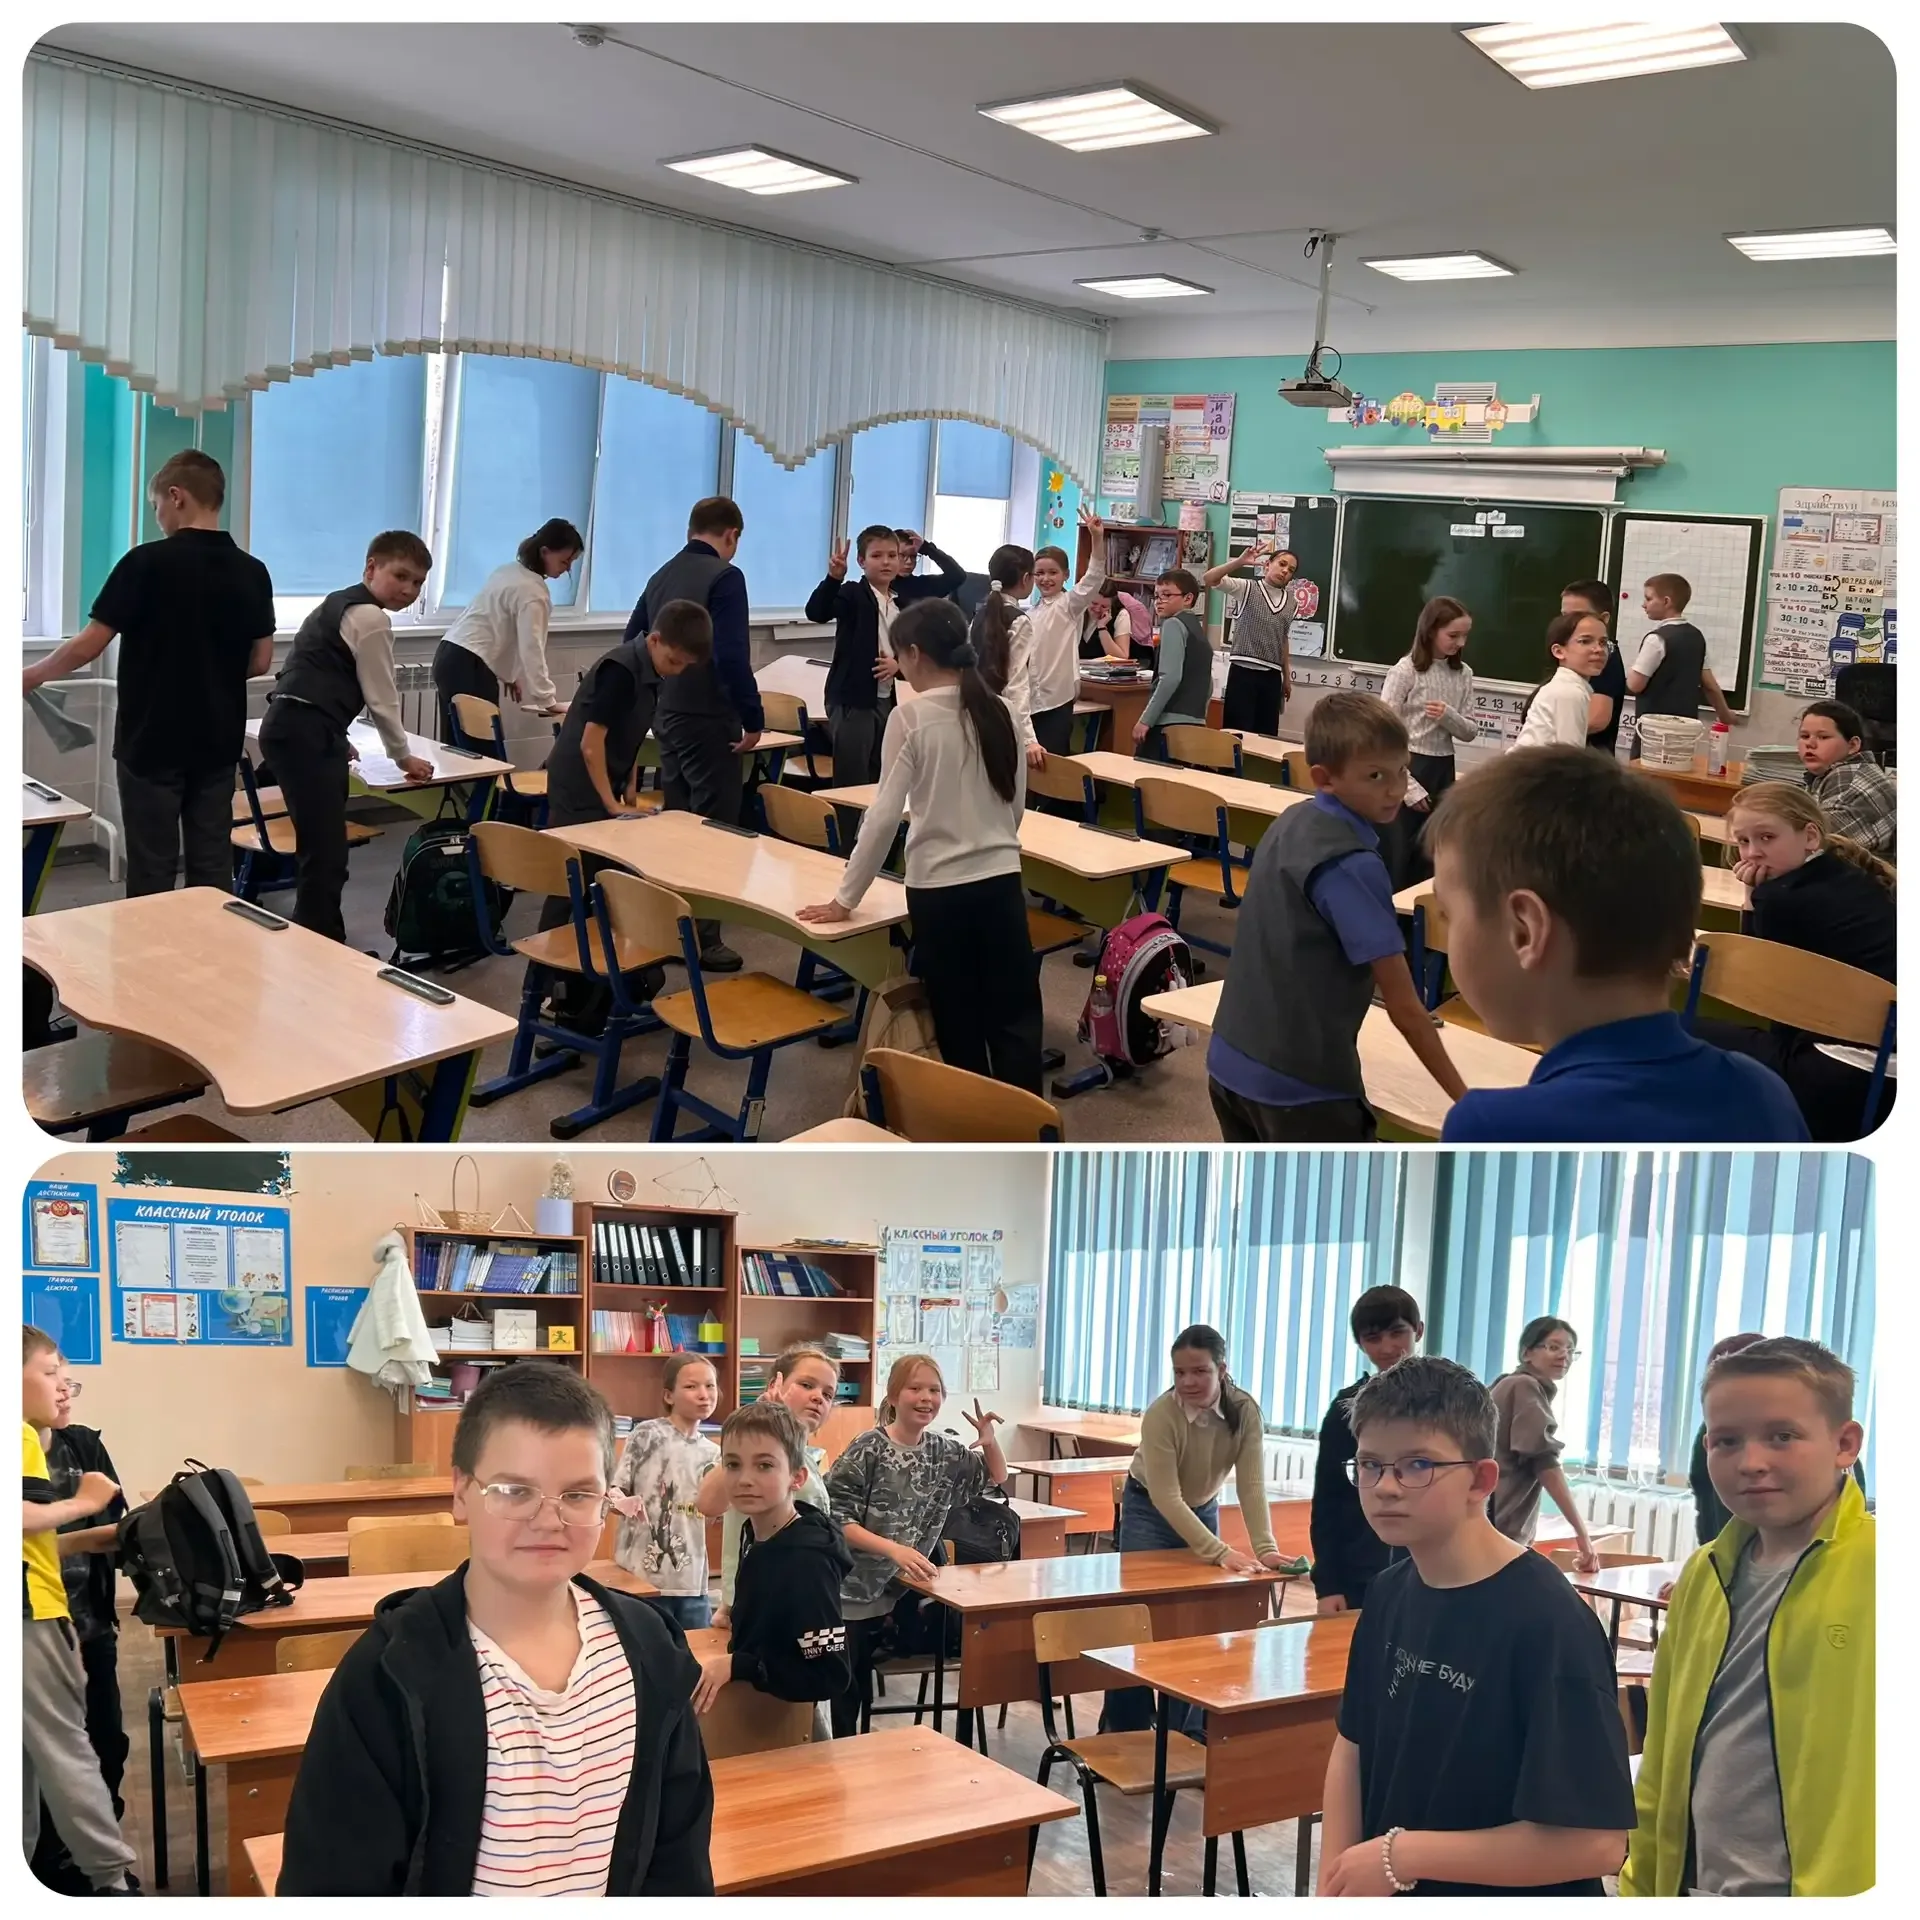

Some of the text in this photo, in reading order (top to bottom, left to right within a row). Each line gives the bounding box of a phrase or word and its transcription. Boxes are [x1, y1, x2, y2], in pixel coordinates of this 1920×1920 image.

[1776, 583, 1781, 591] 2
[1780, 614, 1792, 622] 30
[1799, 616, 1808, 624] 10
[1320, 674, 1328, 684] 2
[1336, 676, 1342, 686] 3
[1350, 678, 1357, 688] 4
[1366, 680, 1373, 690] 5
[1476, 696, 1487, 706] 12
[1492, 698, 1504, 708] 13
[1512, 701, 1523, 712] 14
[1622, 714, 1636, 726] 20
[37, 1190, 80, 1198] ДОСТИЖЕНИЯ
[135, 1204, 264, 1224] КЛАССНЫЙ УГОЛОК
[894, 1230, 988, 1242] КЛАССНЫЙ УГОЛОК
[1438, 1664, 1476, 1692] БУДУ
